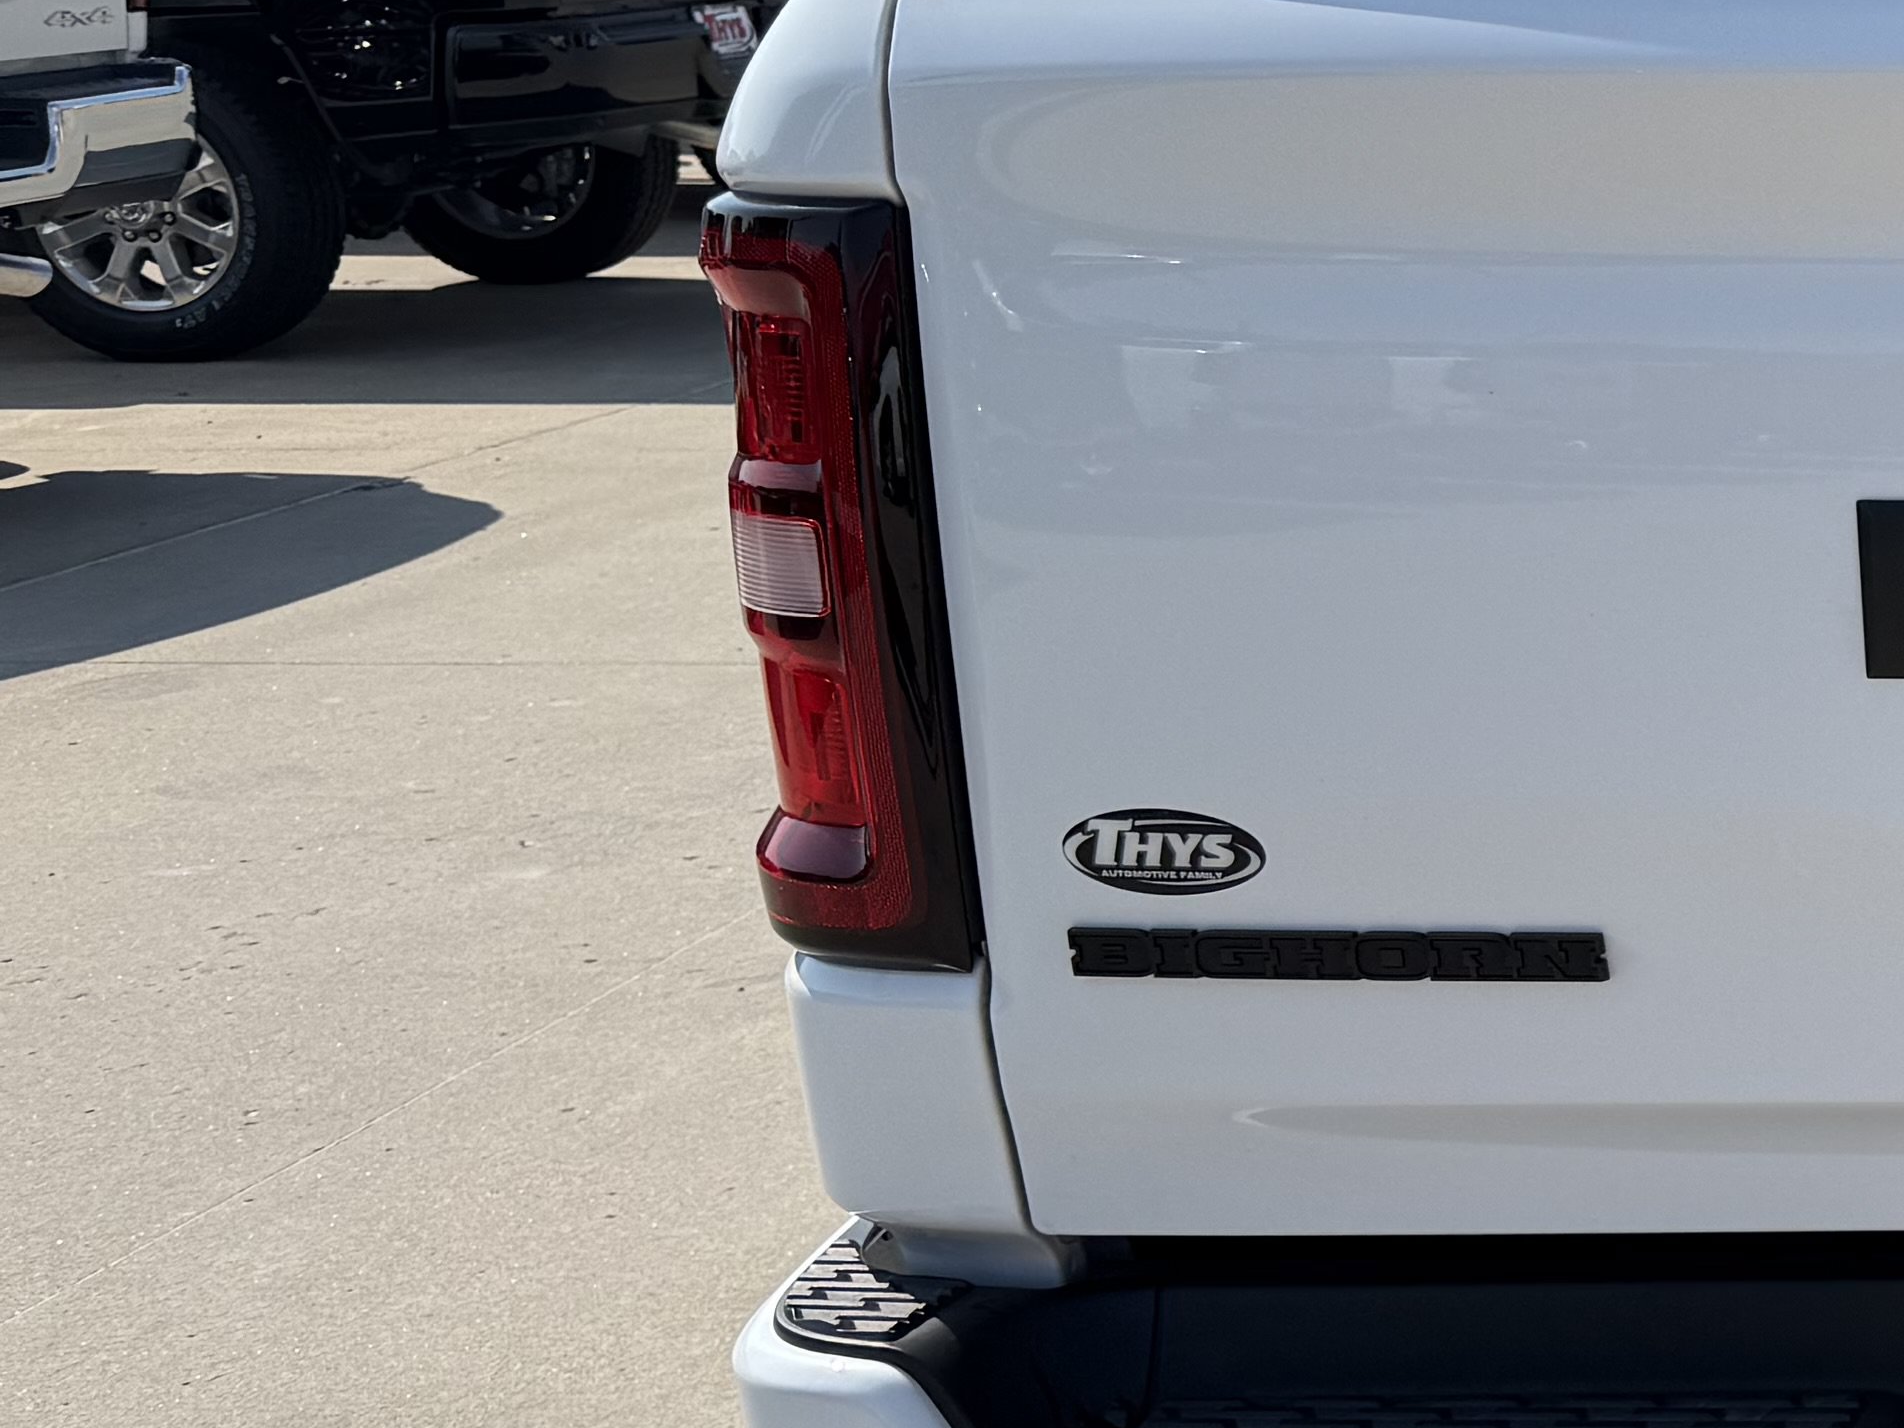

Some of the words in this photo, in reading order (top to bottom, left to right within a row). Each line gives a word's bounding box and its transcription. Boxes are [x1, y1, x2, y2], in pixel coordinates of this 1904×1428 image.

[44, 5, 115, 28] 4x4
[1082, 818, 1236, 869] THYS
[1101, 869, 1177, 880] AUTOMOTIVE
[1179, 869, 1223, 880] FAMILY
